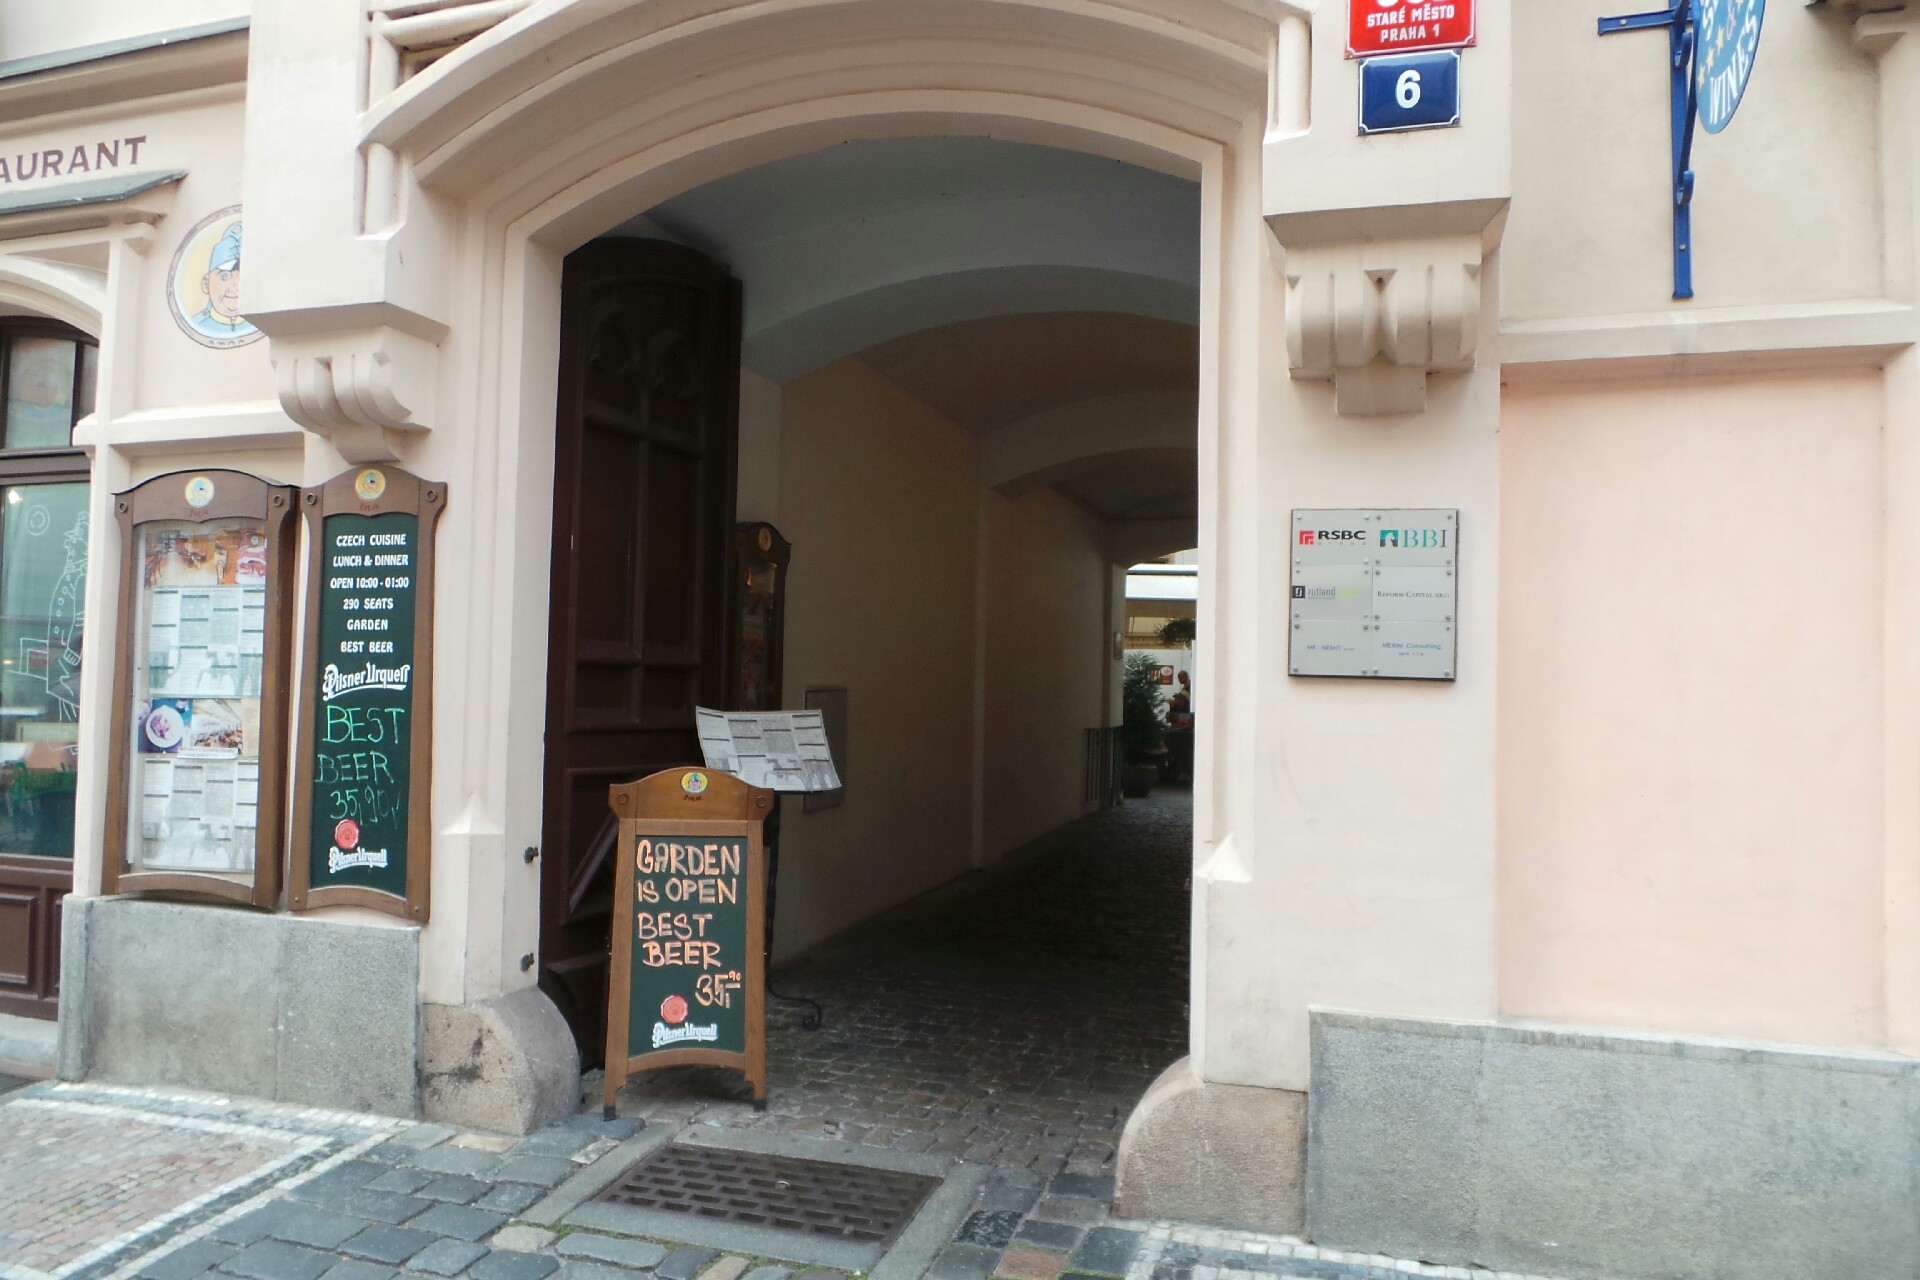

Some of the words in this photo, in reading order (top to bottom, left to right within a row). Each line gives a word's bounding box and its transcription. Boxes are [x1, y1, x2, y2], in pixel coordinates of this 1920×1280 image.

[1367, 6, 1406, 28] STARÉ
[1411, 3, 1455, 22] MĚSTO
[1381, 24, 1426, 43] PRAHA
[1433, 23, 1440, 37] 1
[1709, 0, 1757, 125] WINES
[1396, 69, 1421, 109] 6
[336, 535, 365, 547] CZECH
[369, 534, 406, 546] CUISINE
[1317, 530, 1367, 540] RSBC
[1403, 529, 1448, 548] BBI
[333, 555, 362, 567] LUNCH
[364, 555, 373, 567] &
[374, 554, 409, 566] DINNER
[330, 577, 354, 589] OPEN
[356, 577, 379, 589] 10:00
[384, 577, 409, 588] 01:00
[1308, 587, 1336, 597] rutland
[343, 598, 360, 610] 290
[363, 597, 394, 610] SEATS
[347, 618, 389, 631] GARDEN
[340, 641, 365, 653] BEST
[369, 641, 394, 653] BEER
[322, 663, 367, 702] Pilsner
[365, 661, 411, 690] Urquell
[322, 705, 405, 744] BEST
[314, 751, 394, 784] BEER
[329, 846, 359, 874] Pilsner
[636, 839, 740, 876] GARDEN
[636, 879, 660, 904] IS
[665, 877, 737, 904] OPEN
[638, 912, 713, 941] BEST
[642, 941, 722, 970] BEER
[652, 1021, 687, 1049] Pilsner
[685, 1022, 718, 1042] Urquell
